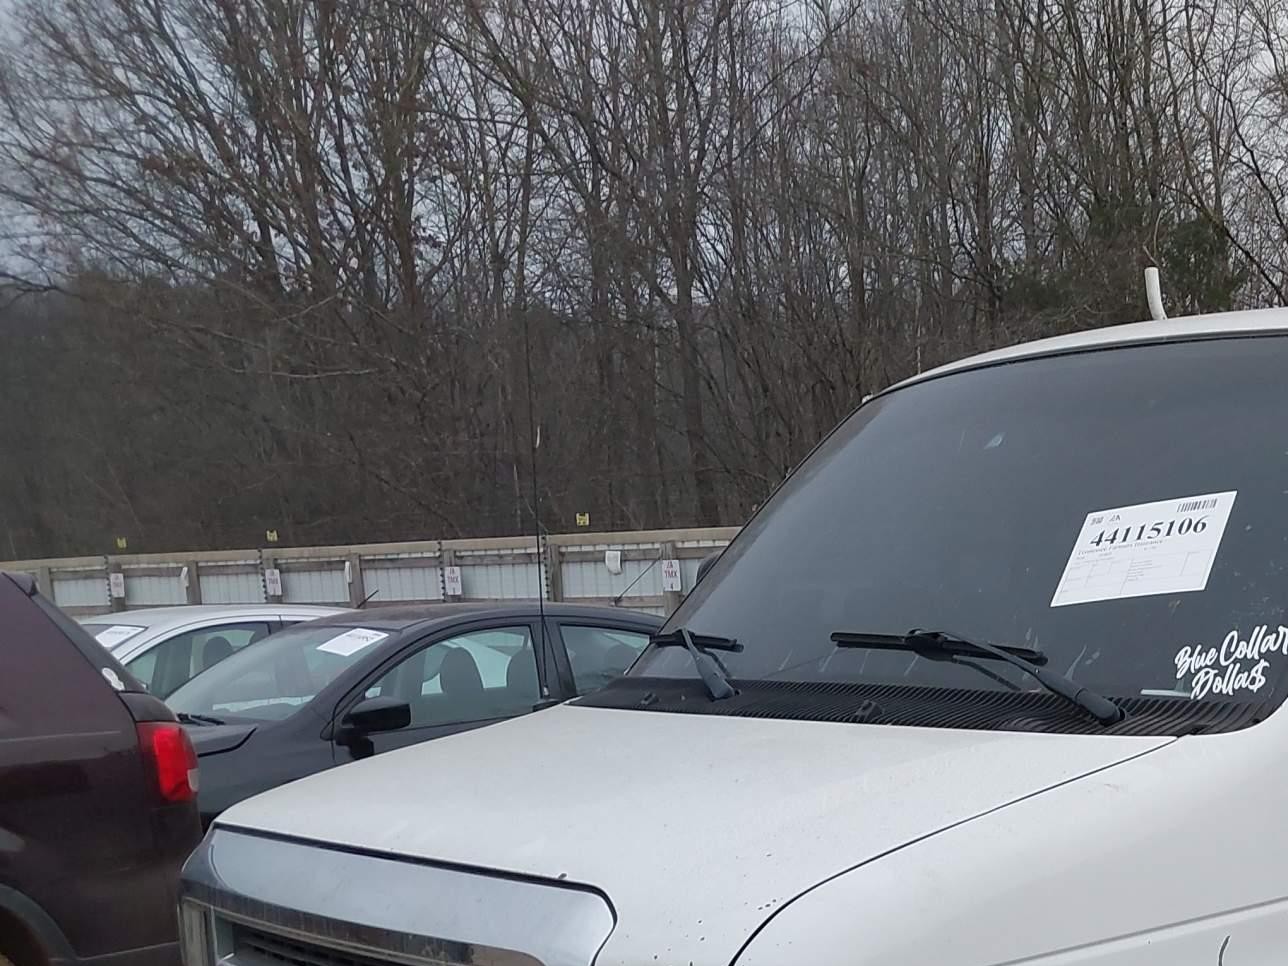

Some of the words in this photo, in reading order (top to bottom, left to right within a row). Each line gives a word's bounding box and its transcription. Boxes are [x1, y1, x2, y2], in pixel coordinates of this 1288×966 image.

[1089, 514, 1210, 547] 44115106
[1174, 644, 1218, 679] Blue
[1190, 658, 1270, 700] Dolla$
